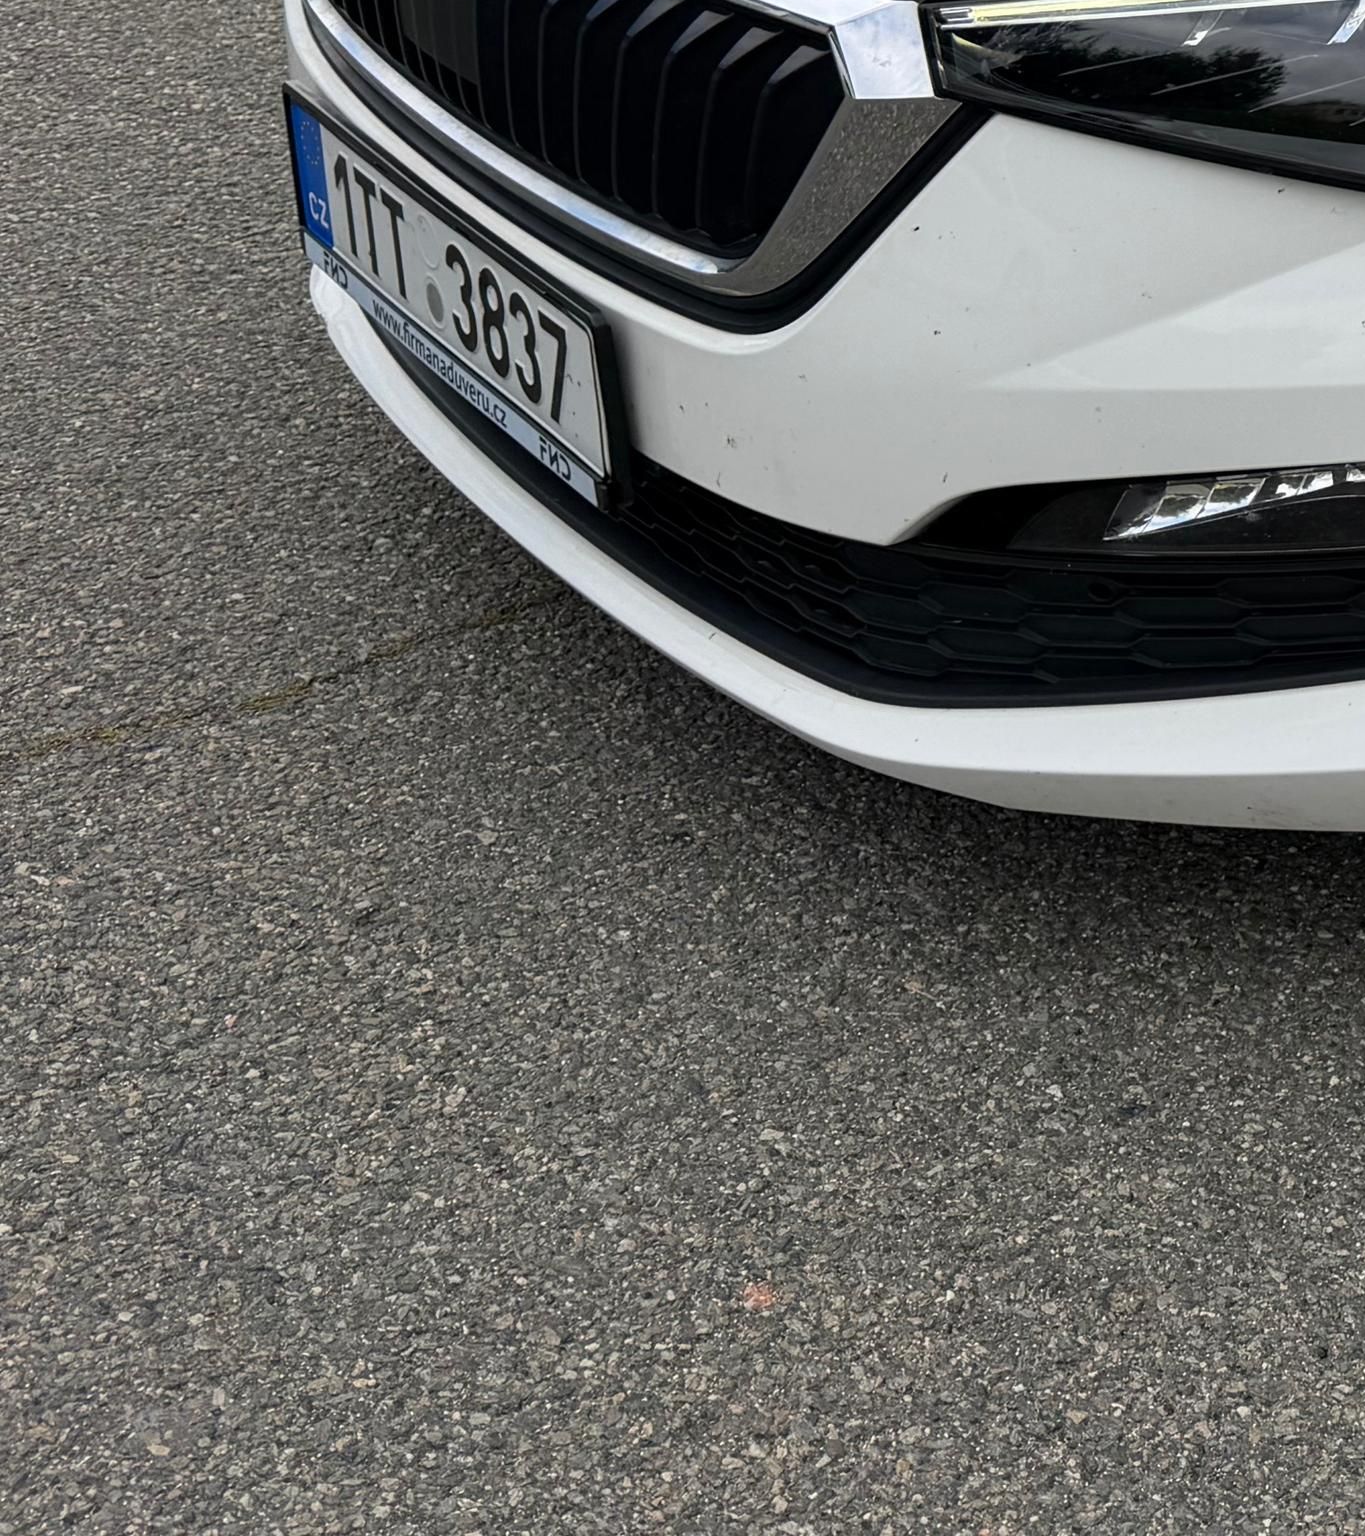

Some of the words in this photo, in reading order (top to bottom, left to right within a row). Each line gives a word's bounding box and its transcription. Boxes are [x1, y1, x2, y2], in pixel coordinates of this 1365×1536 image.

[308, 190, 330, 229] CZ
[334, 153, 408, 301] 1TT
[444, 243, 568, 425] 3837
[372, 299, 508, 429] www.firmanaduveru.cz
